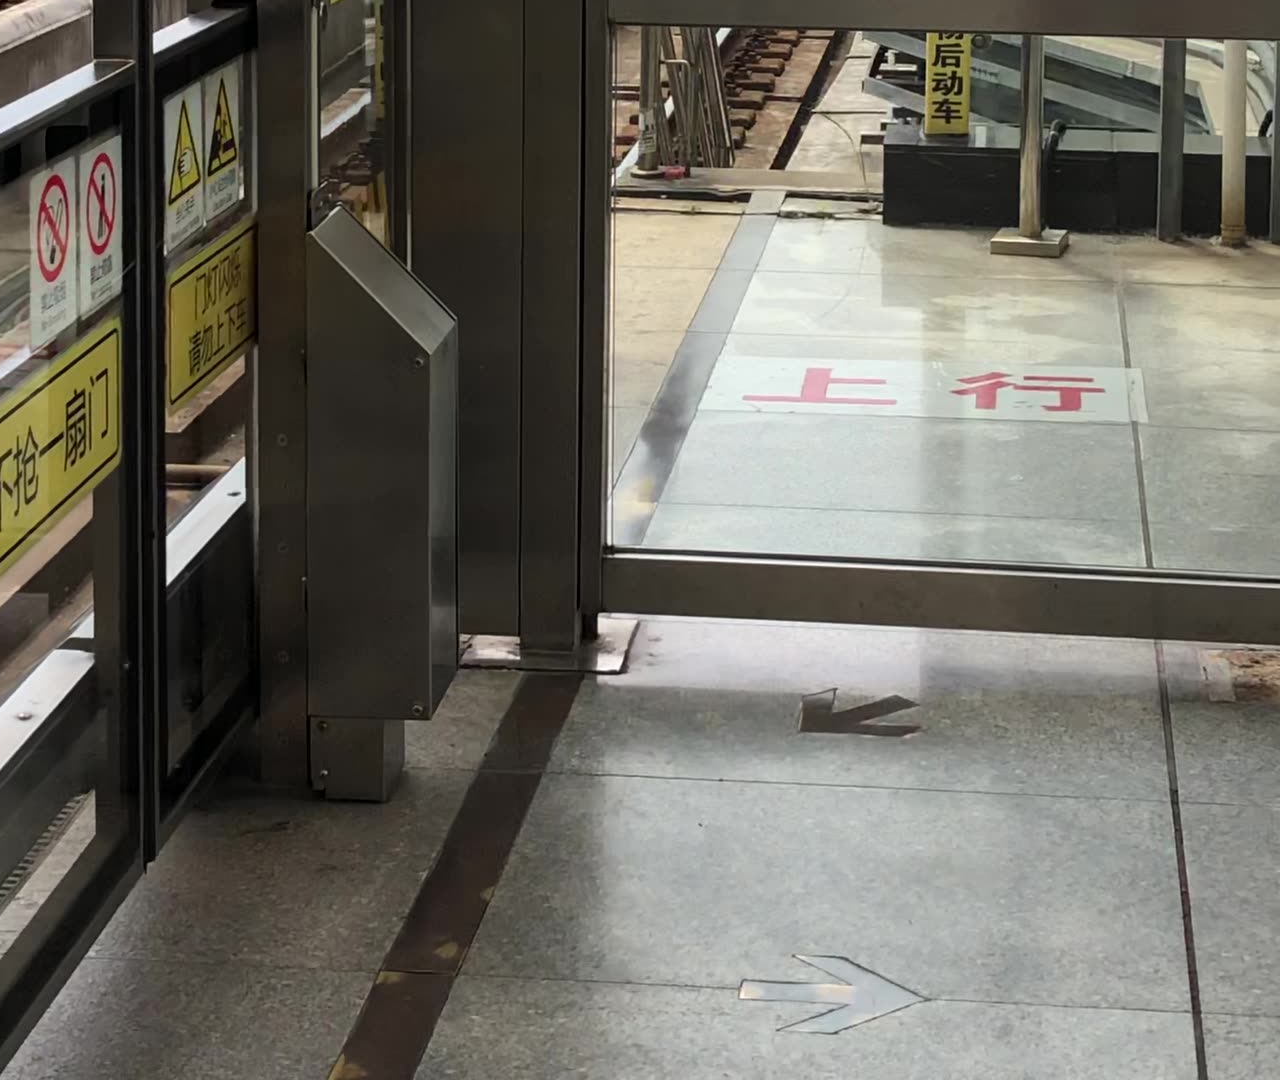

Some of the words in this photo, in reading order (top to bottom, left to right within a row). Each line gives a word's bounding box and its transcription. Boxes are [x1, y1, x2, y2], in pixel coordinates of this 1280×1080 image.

[189, 298, 248, 377] 请勿上下车
[742, 367, 1106, 413] 上行
